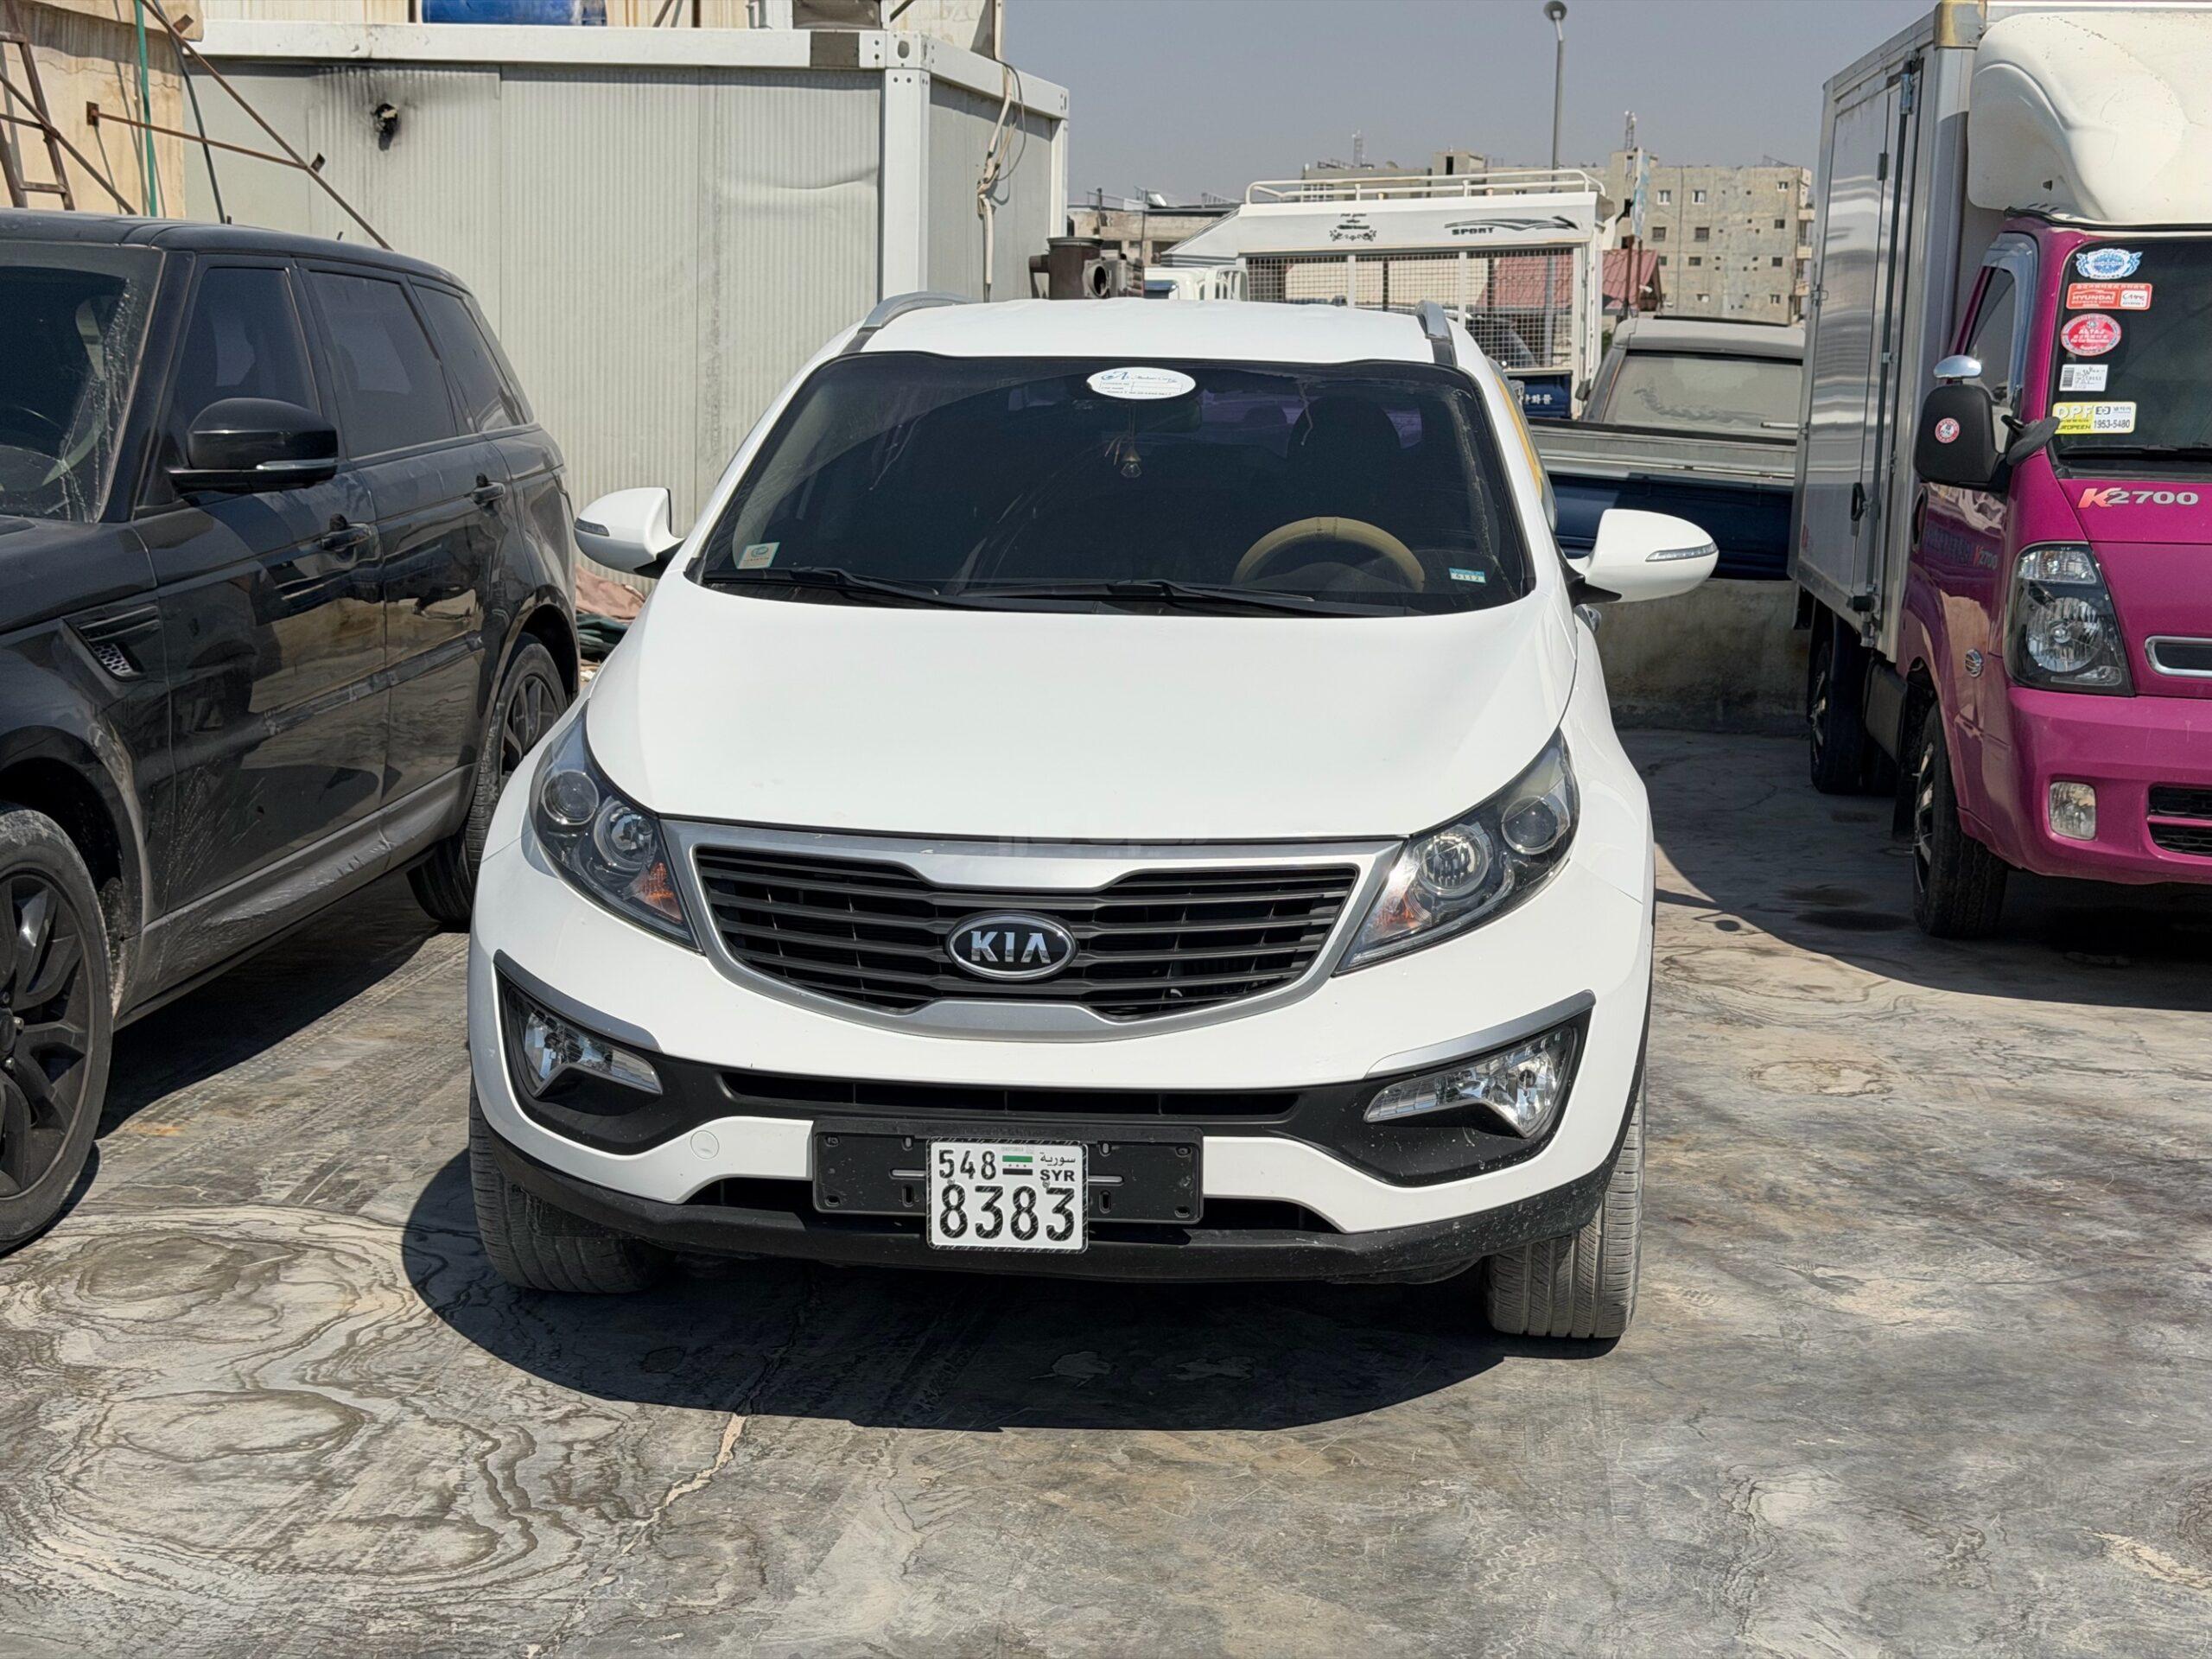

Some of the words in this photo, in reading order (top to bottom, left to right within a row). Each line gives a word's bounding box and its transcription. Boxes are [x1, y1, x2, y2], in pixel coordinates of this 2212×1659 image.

[2056, 406, 2093, 418] DPF
[2094, 420, 2131, 429] 1953-5480
[2078, 487, 2199, 508] K2700
[970, 931, 1052, 963] KIA
[938, 1149, 996, 1180] 548
[1039, 1152, 1077, 1166] سورية
[1039, 1169, 1075, 1182] SYR
[939, 1184, 1075, 1242] 8383
